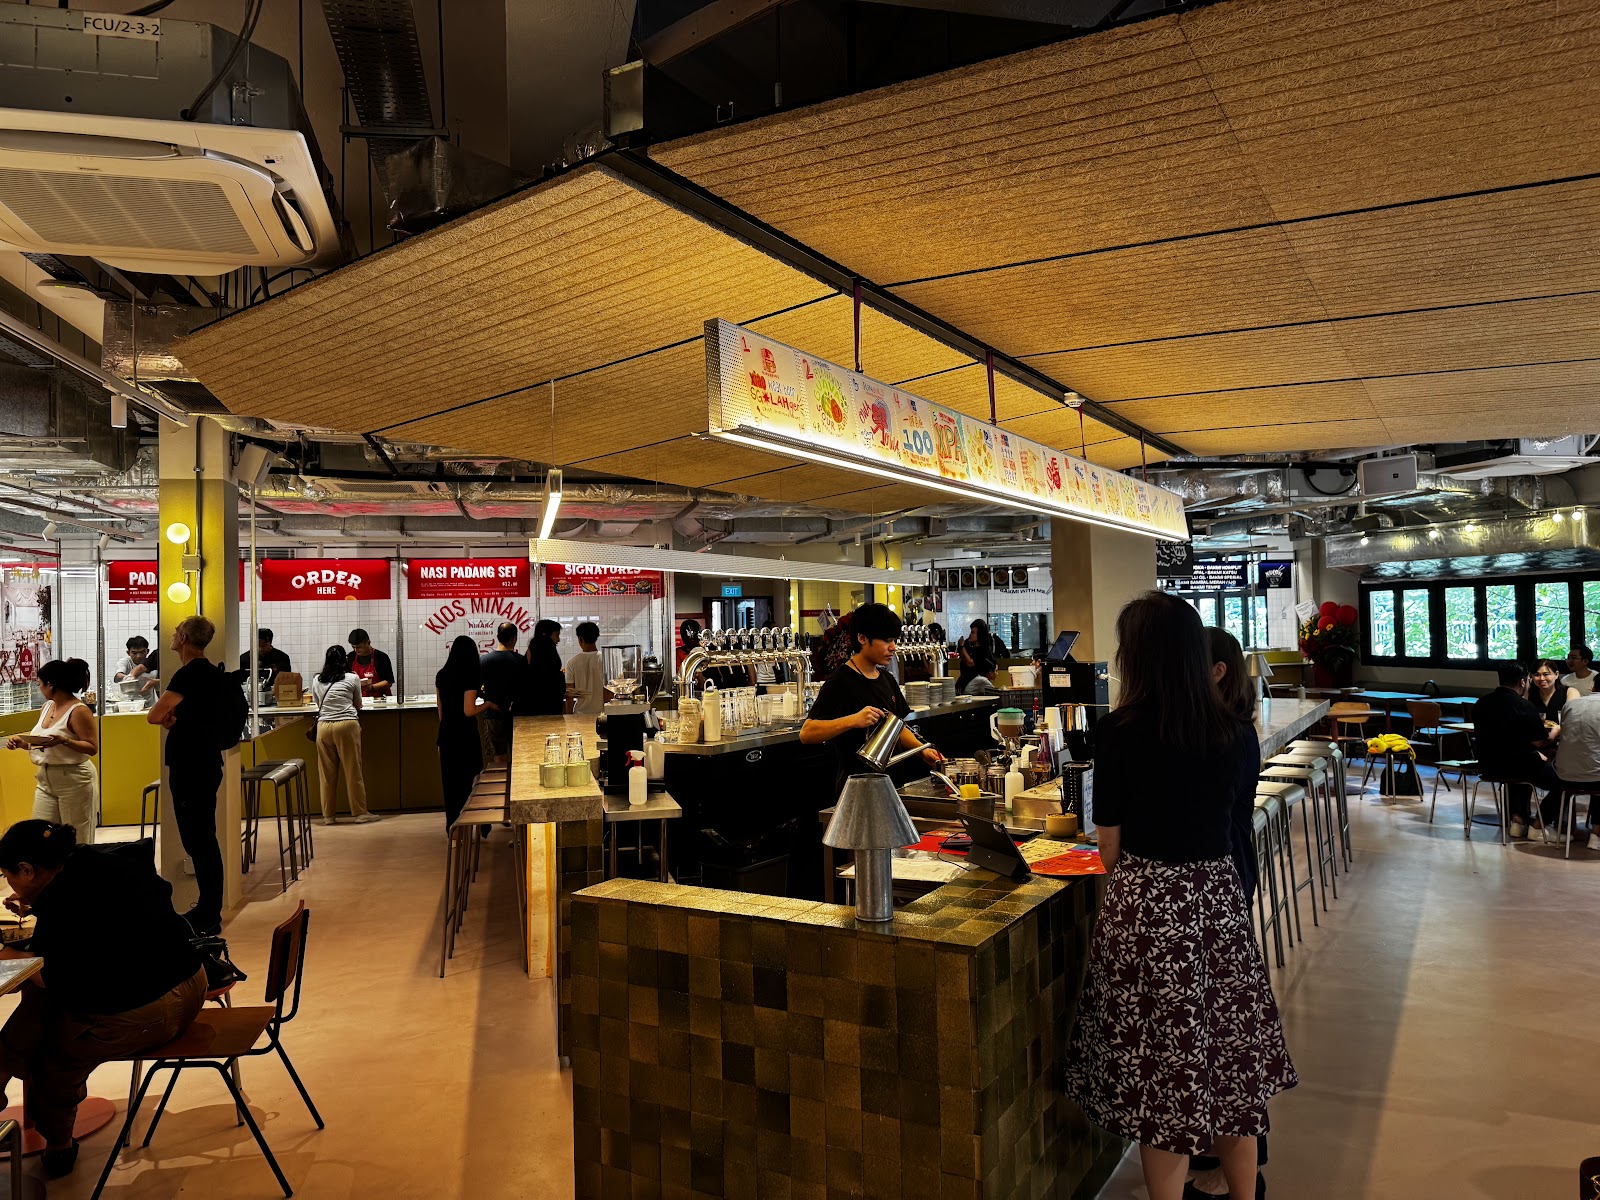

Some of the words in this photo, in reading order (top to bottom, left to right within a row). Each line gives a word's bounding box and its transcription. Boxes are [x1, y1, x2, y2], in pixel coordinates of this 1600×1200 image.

[84, 17, 160, 36] FCU/2-3-2
[903, 429, 934, 455] 100
[420, 566, 448, 579] NASI
[450, 566, 495, 579] PADANG
[498, 565, 518, 578] SET
[564, 563, 641, 576] SIGNATURES
[128, 571, 157, 586] PAD
[291, 569, 362, 590] ORDER
[317, 586, 336, 595] HERE
[424, 599, 466, 635] KIOS
[470, 597, 532, 634] MINANG
[467, 619, 495, 629] MINANG
